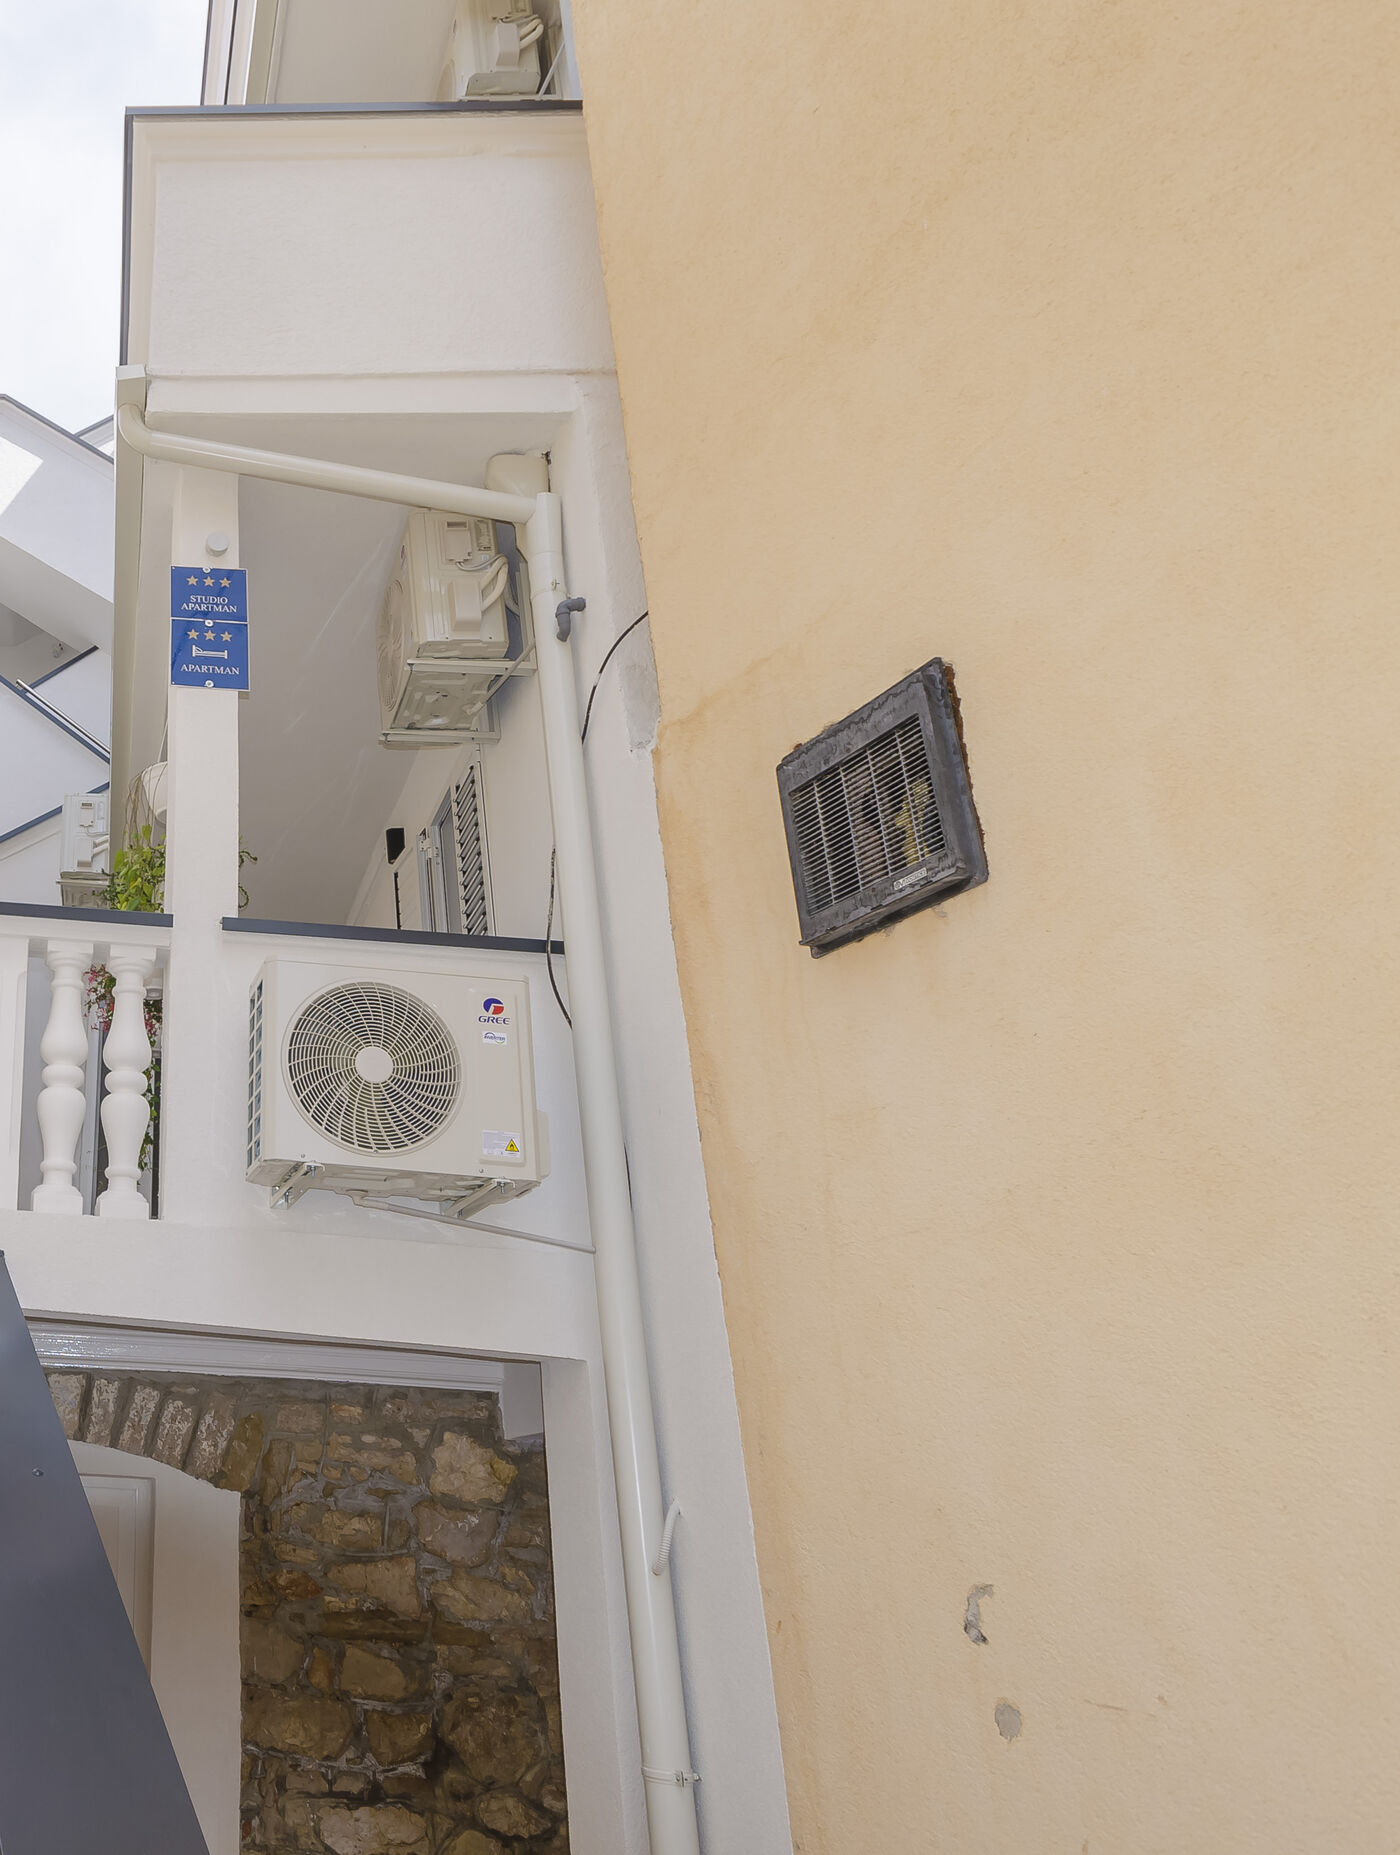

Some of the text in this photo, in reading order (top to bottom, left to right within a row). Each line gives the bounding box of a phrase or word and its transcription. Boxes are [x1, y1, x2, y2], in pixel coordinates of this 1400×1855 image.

[190, 595, 228, 604] STUDIO
[181, 603, 237, 613] APARTMAN
[180, 664, 240, 675] APARTMAN
[478, 1015, 510, 1025] GREE
